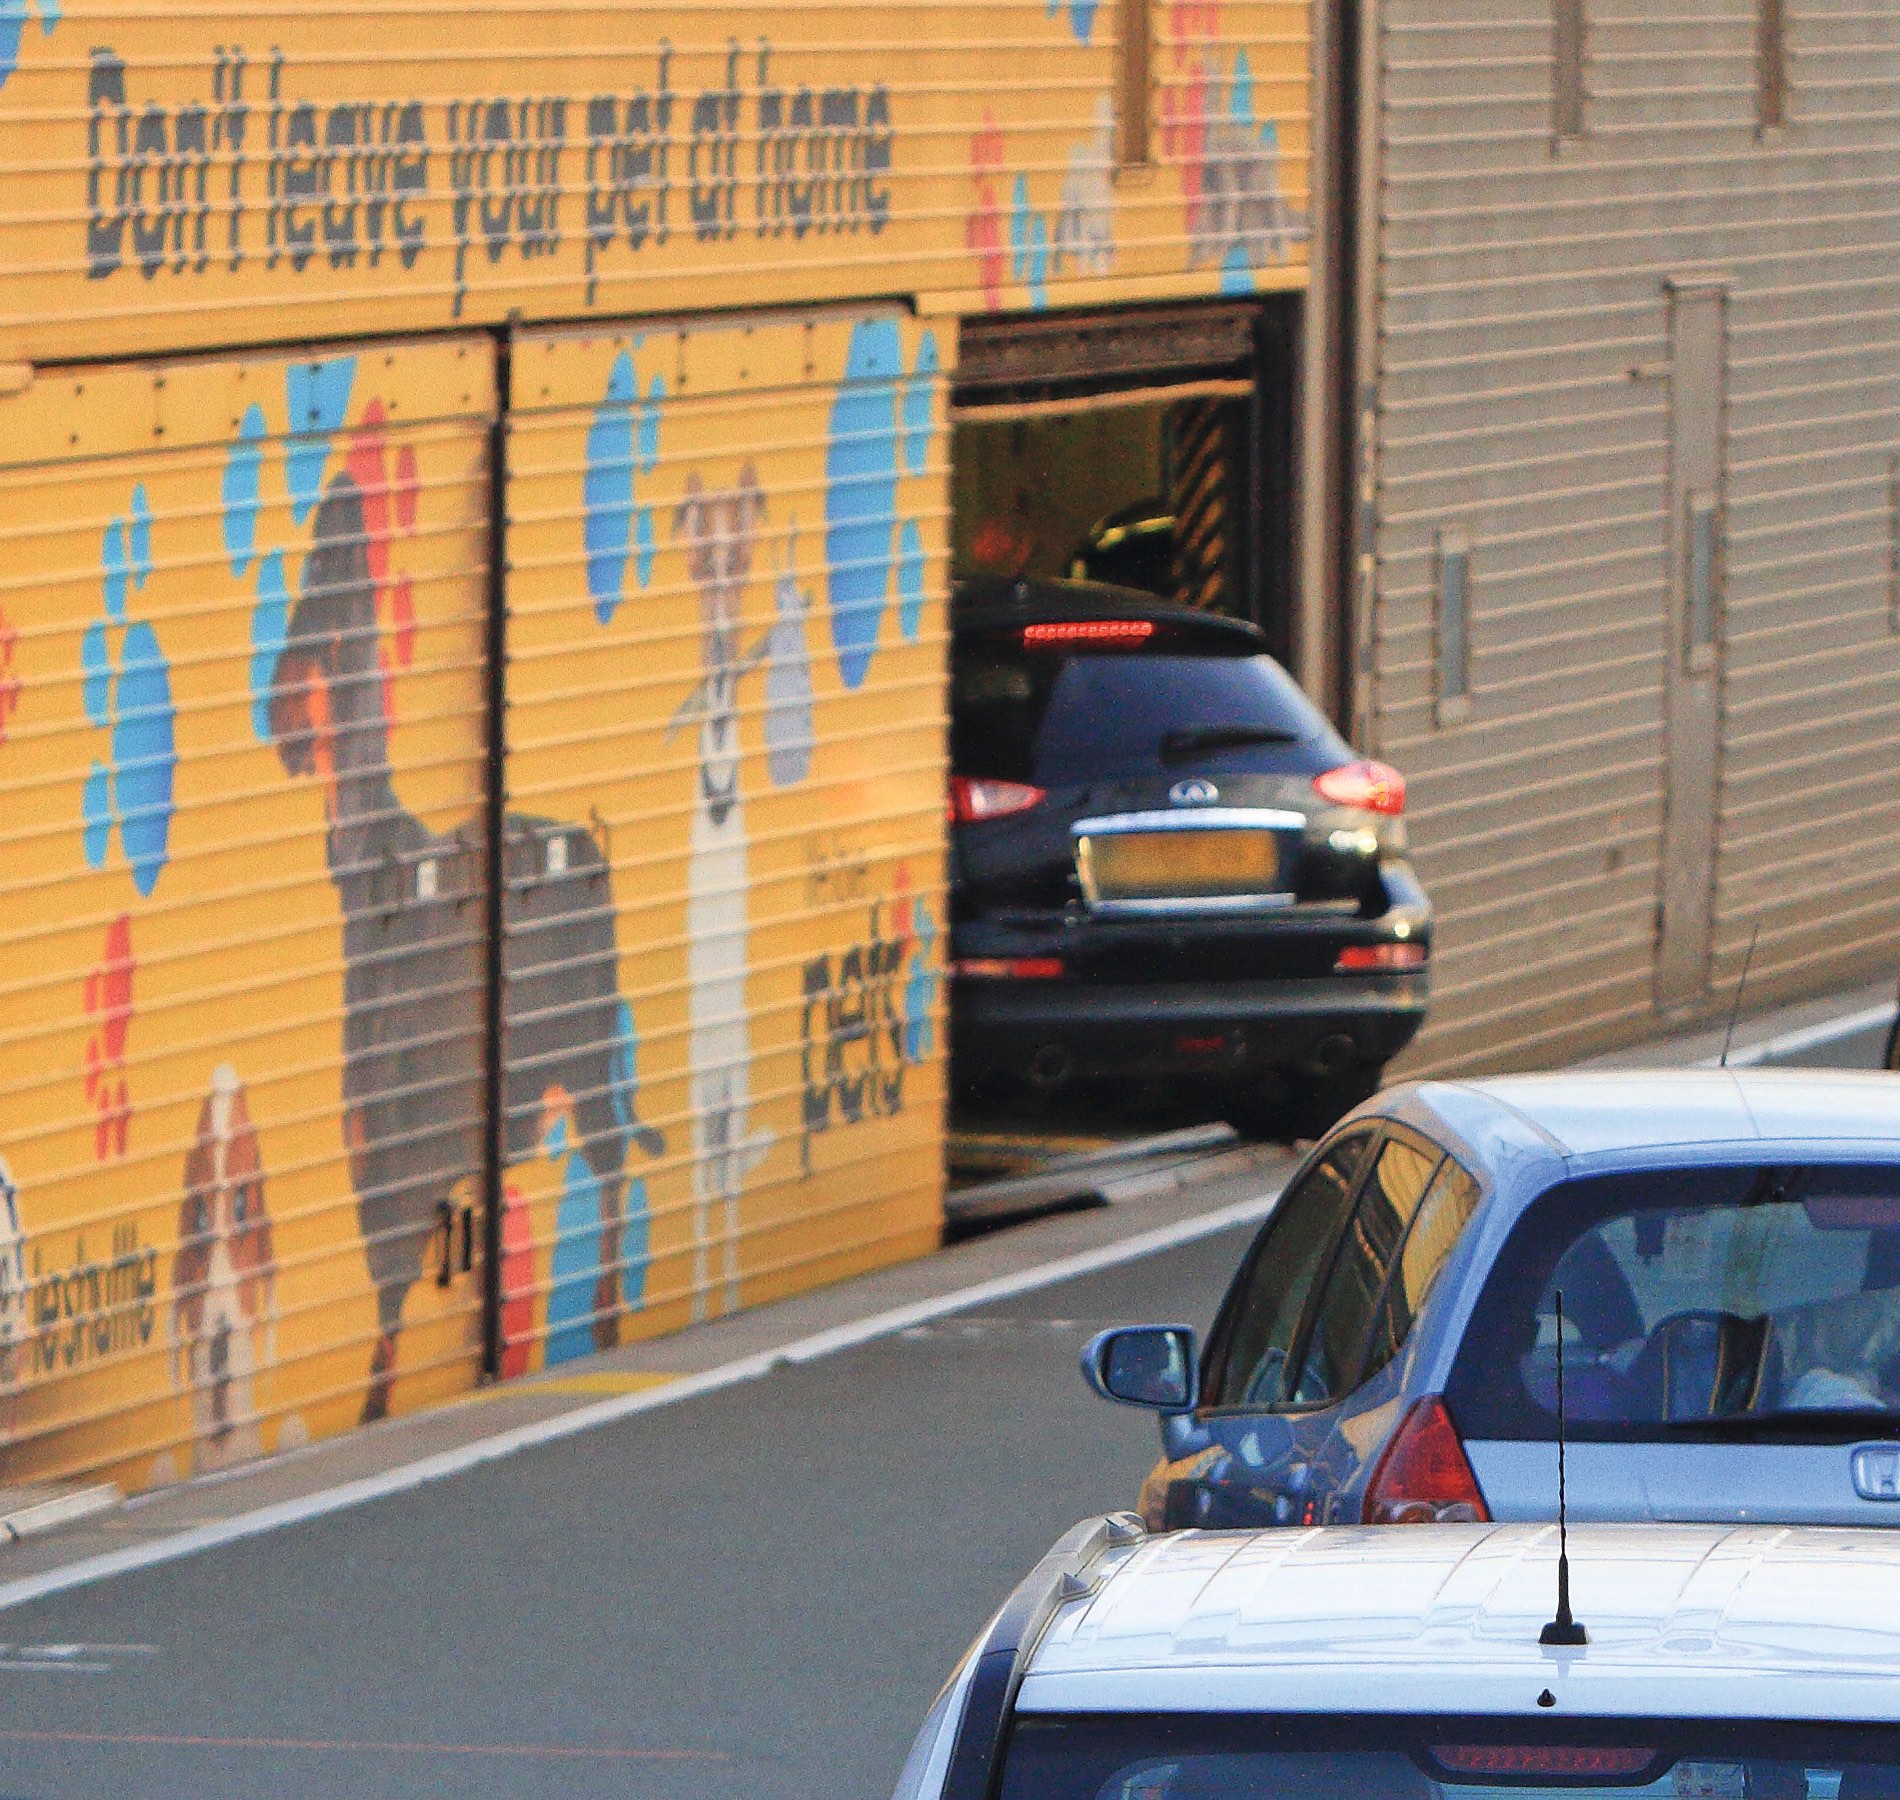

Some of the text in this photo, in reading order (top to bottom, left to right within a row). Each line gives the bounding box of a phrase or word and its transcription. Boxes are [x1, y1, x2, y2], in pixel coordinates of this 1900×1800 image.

[87, 34, 891, 318] Don't leave your pet at home
[801, 896, 904, 1178] pets
